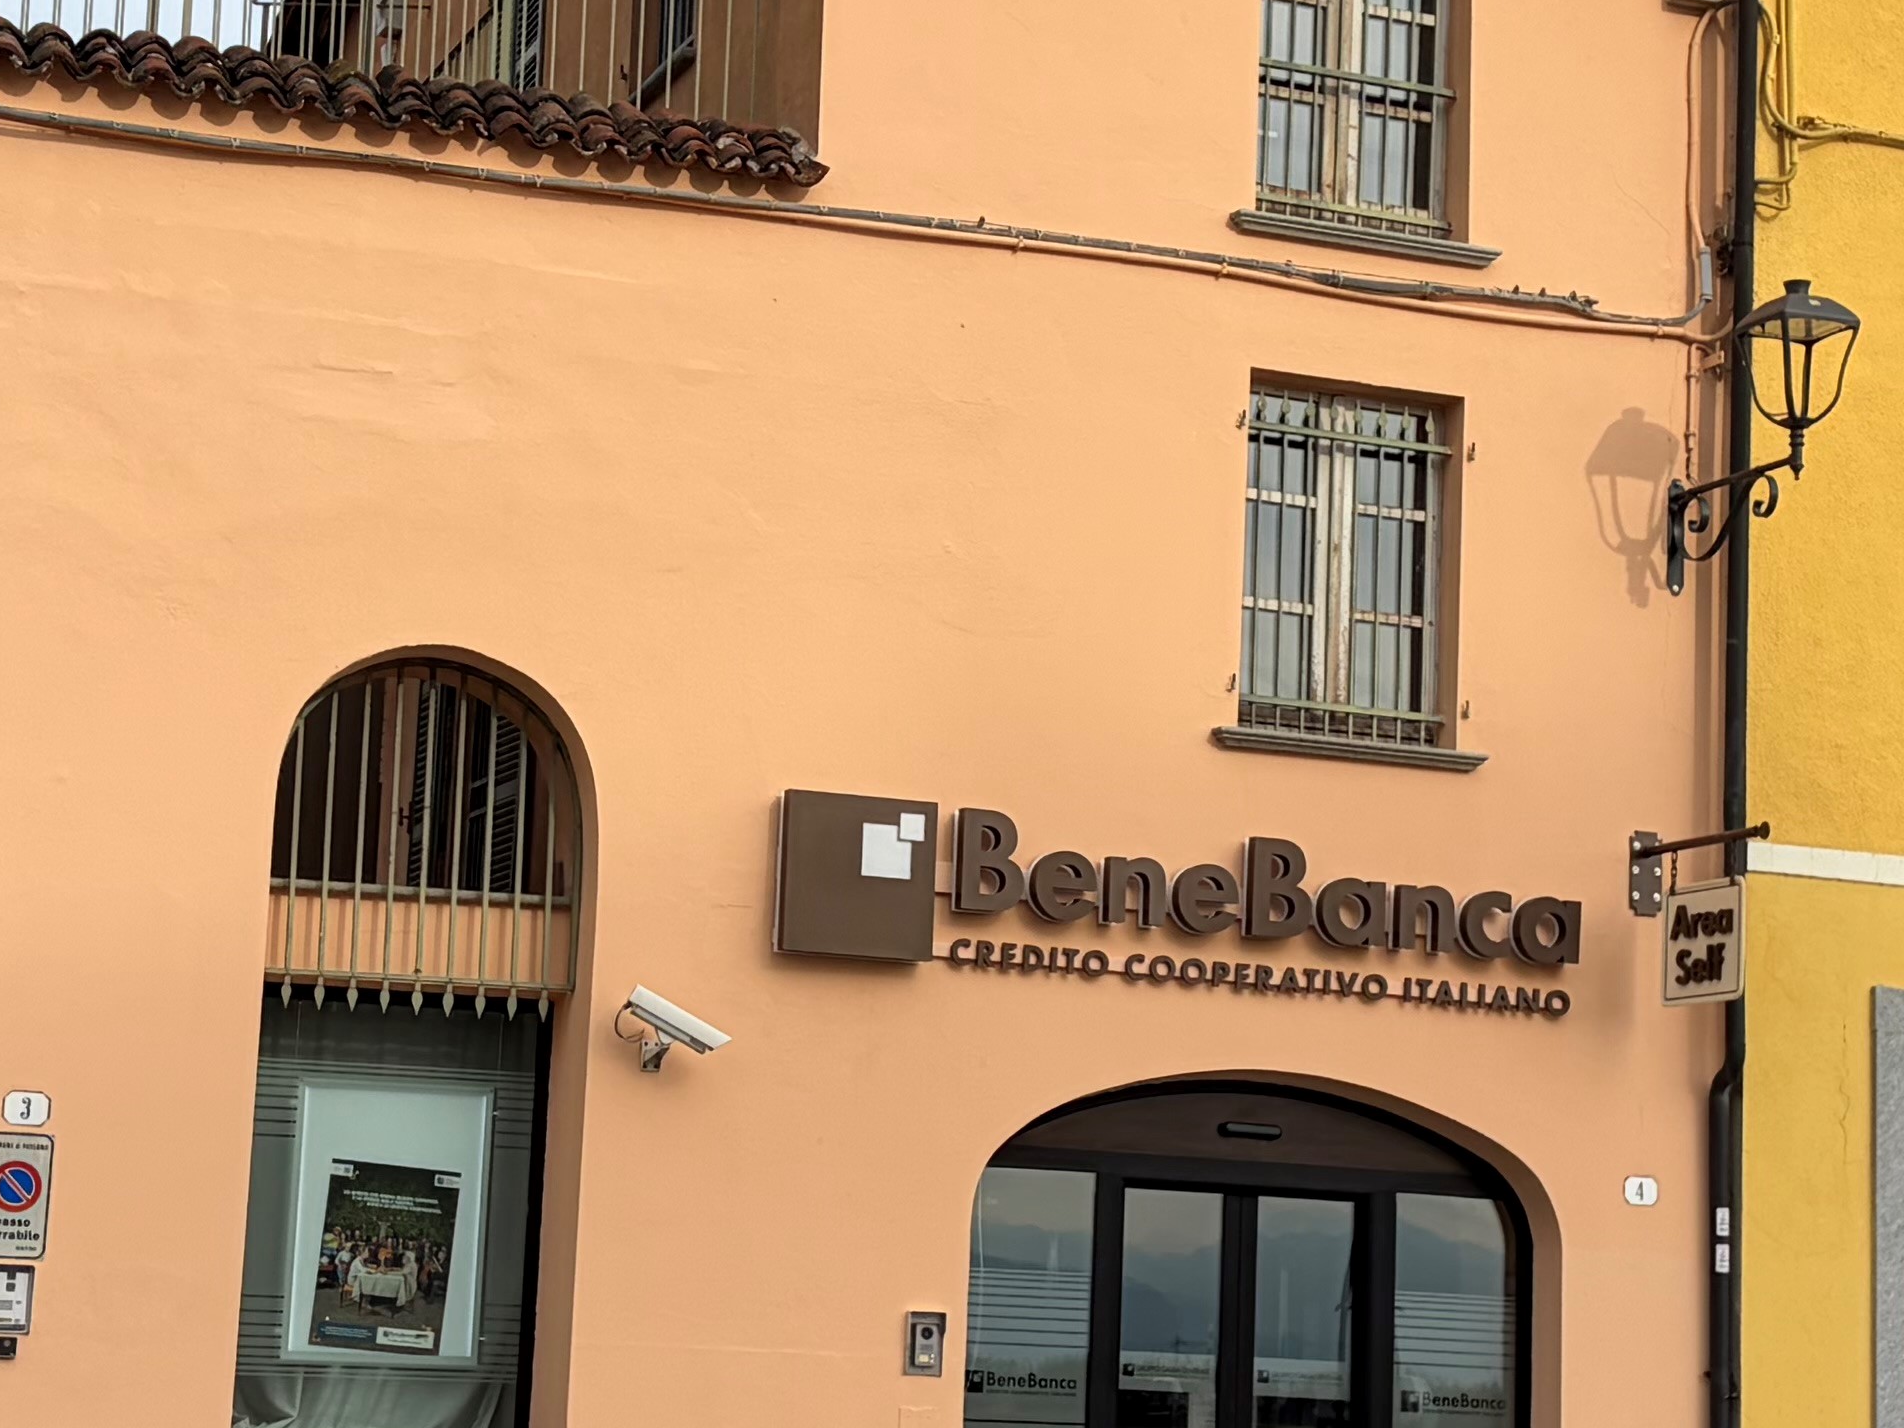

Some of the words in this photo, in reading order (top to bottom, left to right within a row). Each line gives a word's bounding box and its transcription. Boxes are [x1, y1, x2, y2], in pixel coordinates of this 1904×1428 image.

[952, 807, 1582, 965] BeneBanca
[1669, 904, 1734, 941] Area
[949, 938, 1109, 977] CREDITO
[1124, 953, 1388, 1001] COOPERATIVO
[1402, 977, 1571, 1018] ITALIANO
[1674, 942, 1726, 986] Self
[20, 1097, 32, 1120] 3
[1635, 1181, 1644, 1201] 4
[986, 1371, 1077, 1390] BeneBanca
[1422, 1391, 1506, 1410] BeneBanca
